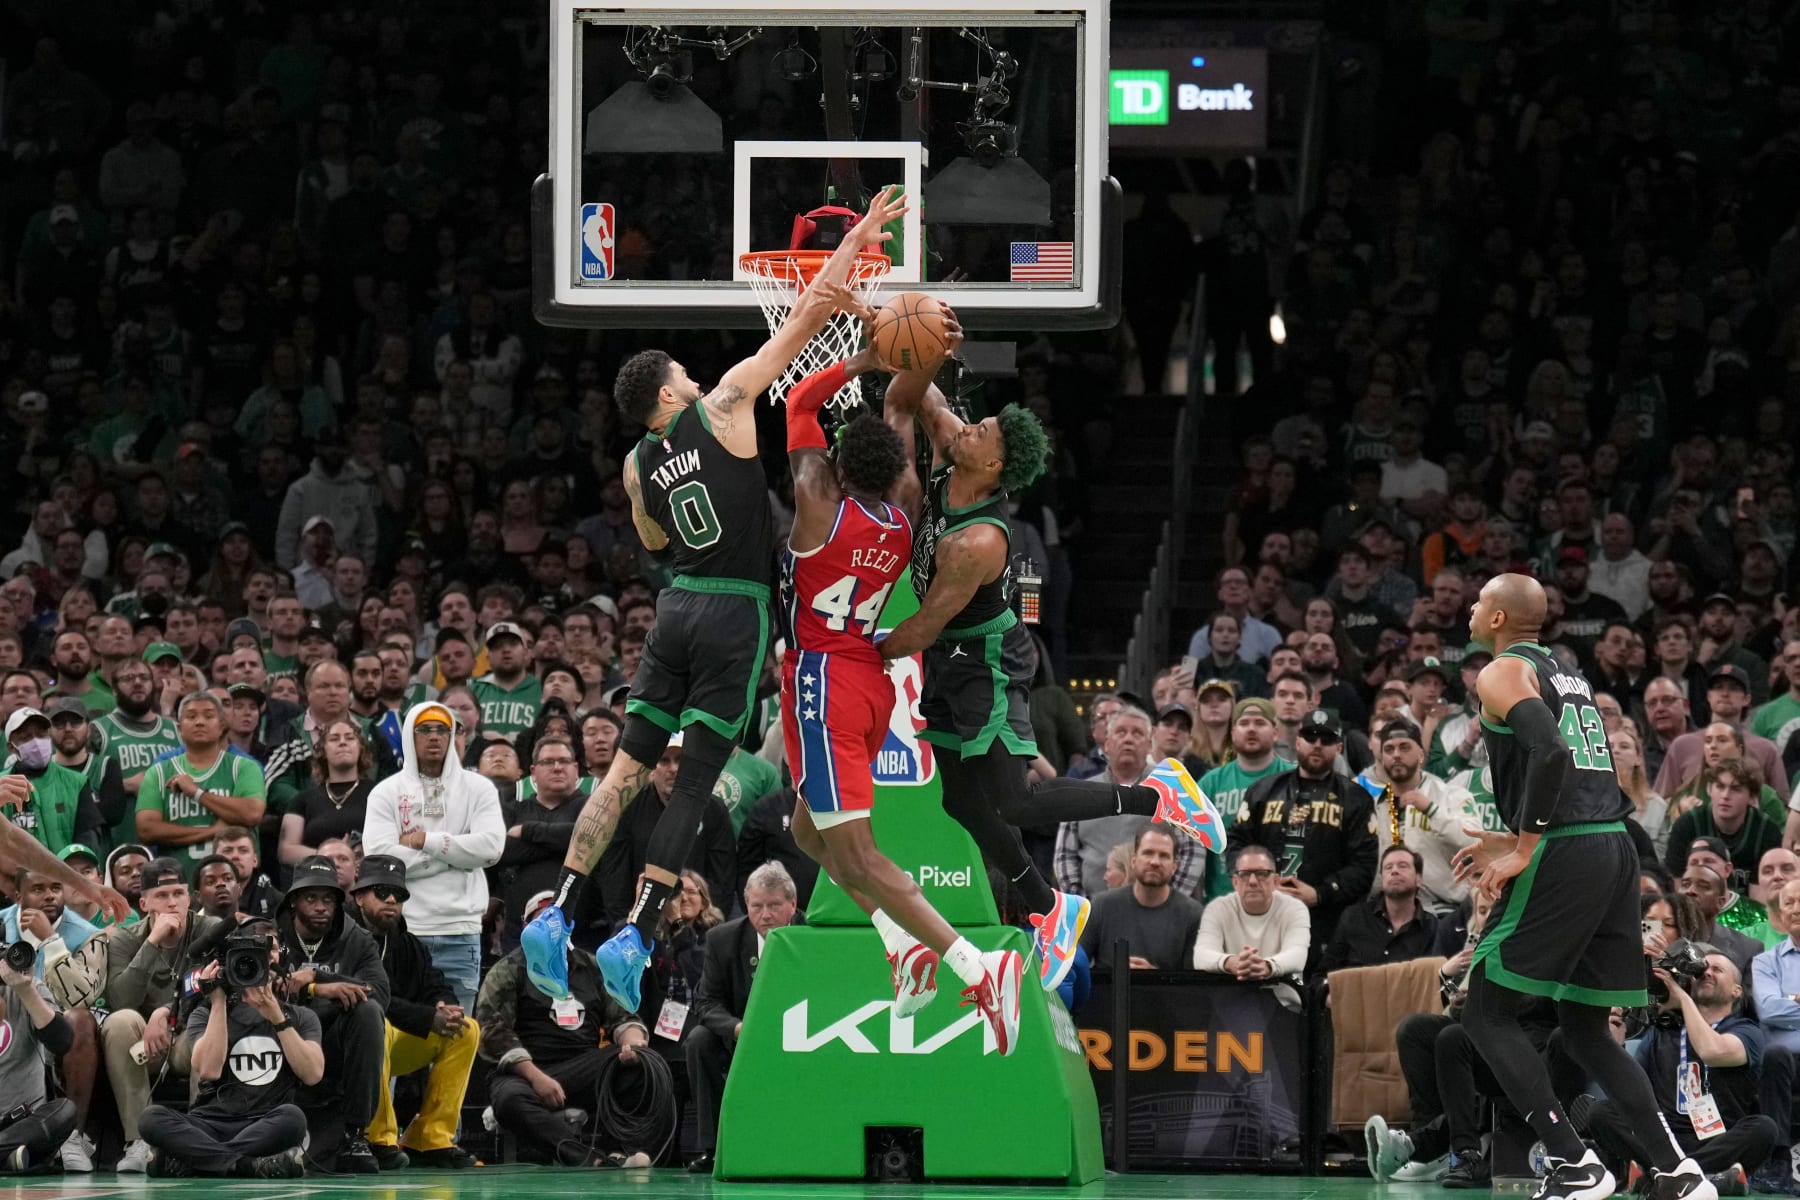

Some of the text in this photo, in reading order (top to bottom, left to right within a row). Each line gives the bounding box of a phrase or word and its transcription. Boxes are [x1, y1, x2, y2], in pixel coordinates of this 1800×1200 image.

[1113, 80, 1254, 114] TD Bank
[585, 263, 602, 275] NBA
[650, 449, 701, 490] TATUM
[669, 480, 722, 550] 0
[851, 548, 899, 573] REED
[811, 574, 893, 638] 44
[480, 701, 535, 729] ELTICS
[1558, 702, 1614, 773] 42
[876, 750, 909, 775] NBA
[919, 866, 971, 887] Pixel
[782, 999, 1000, 1056] KIA
[230, 1050, 283, 1072] TNT
